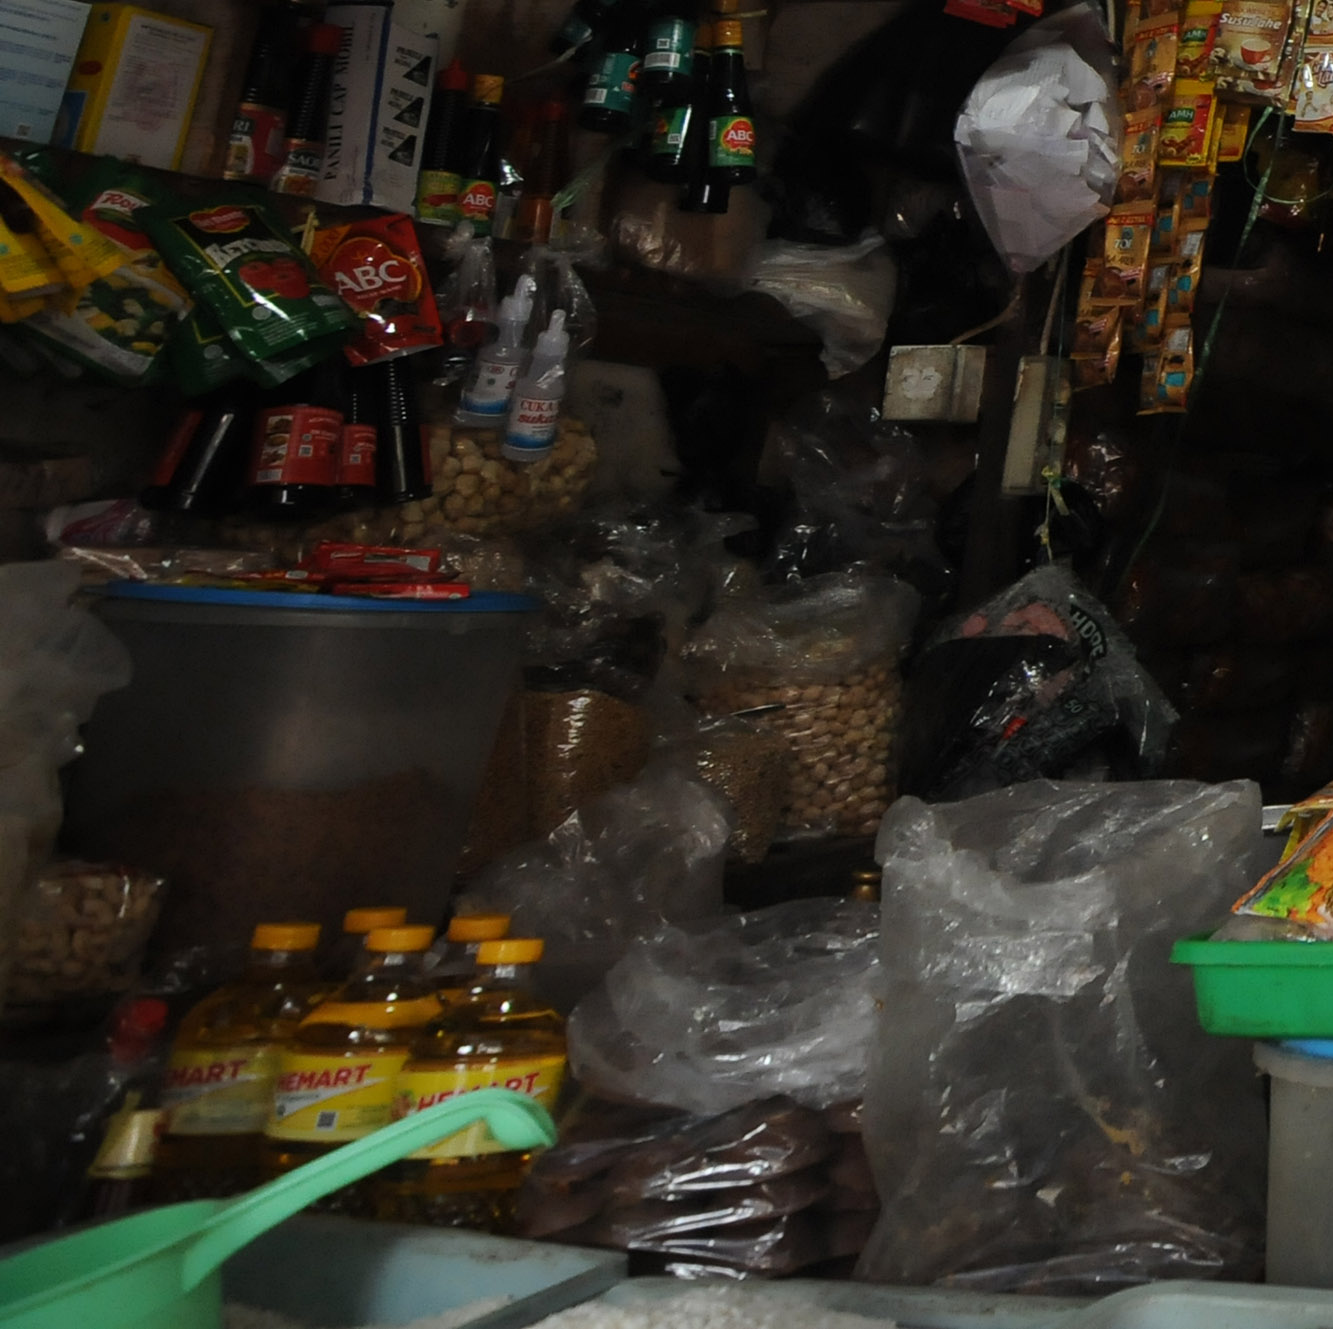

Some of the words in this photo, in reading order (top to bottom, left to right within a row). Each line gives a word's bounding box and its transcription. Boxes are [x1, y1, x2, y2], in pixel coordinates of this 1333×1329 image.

[1219, 13, 1251, 27] Susu
[1250, 16, 1282, 30] Jahe
[339, 26, 354, 80] MOBIL
[331, 83, 348, 118] CAP
[726, 128, 753, 143] ABC
[324, 120, 346, 181] PANILI
[462, 192, 494, 209] ABC
[334, 259, 408, 296] ABC
[519, 399, 553, 413] CUKA
